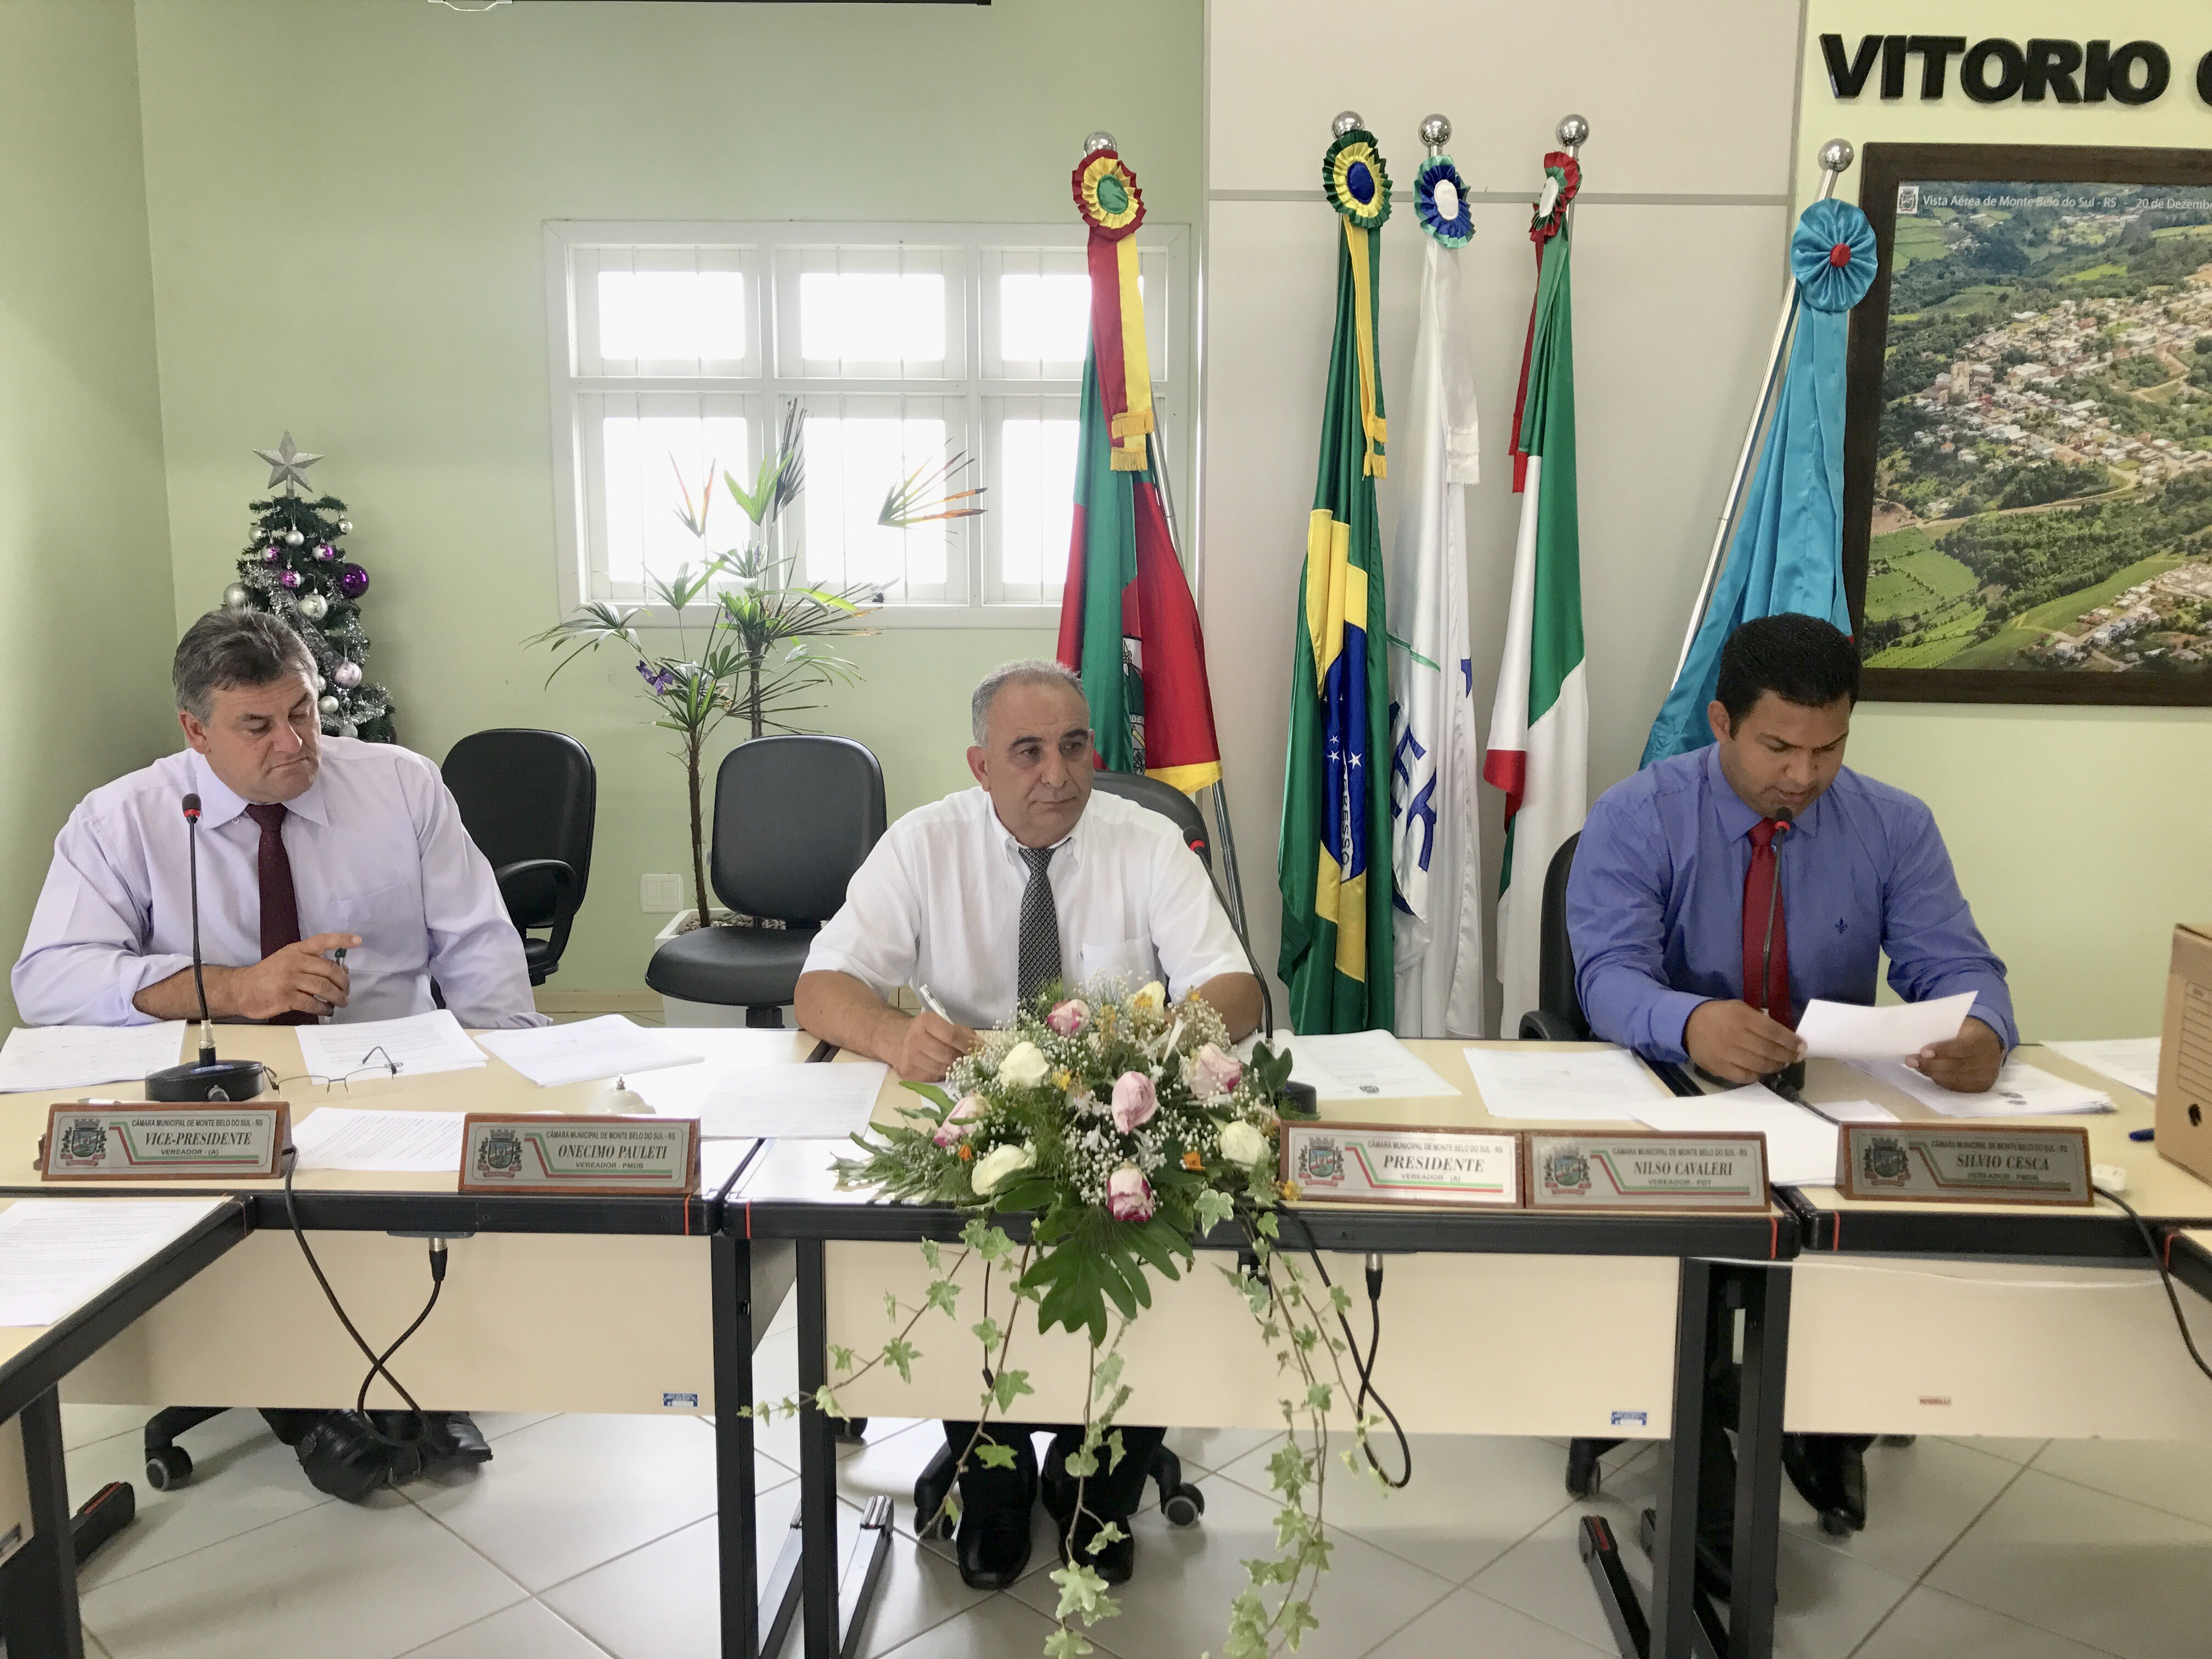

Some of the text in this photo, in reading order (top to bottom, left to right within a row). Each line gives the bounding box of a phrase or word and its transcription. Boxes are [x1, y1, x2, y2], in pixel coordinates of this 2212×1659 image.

[1819, 33, 2171, 105] VITORIO
[1923, 195, 1948, 206] Vista
[1950, 194, 1980, 206] Aérea
[1983, 195, 1997, 207] de
[1999, 195, 2031, 207] Monte
[2062, 196, 2076, 207] do
[2079, 196, 2095, 208] Sul
[2103, 196, 2117, 208] RS
[2137, 198, 2149, 208] 20
[2151, 198, 2164, 209] de
[132, 1119, 155, 1127] CÂMARA
[156, 1119, 185, 1127] MUNICIPAL
[187, 1119, 194, 1127] DE
[145, 1132, 252, 1145] VICE-PRESIDENTE
[546, 1130, 569, 1138] CÂMARA
[571, 1131, 599, 1139] MUNICIPAL
[629, 1132, 644, 1140] BELO
[644, 1132, 652, 1140] DO
[668, 1132, 675, 1140] RS
[558, 1144, 668, 1159] ONECIMO PAULETI
[1393, 1141, 1422, 1150] MUNICIPAL
[1424, 1142, 1432, 1150] DE
[1383, 1154, 1485, 1172] PRESIDENTE
[1634, 1161, 1733, 1176] NILSO CAVALERI
[1957, 1154, 2050, 1171] SILVIO CESCA
[1401, 1172, 1443, 1181] VEREADOR
